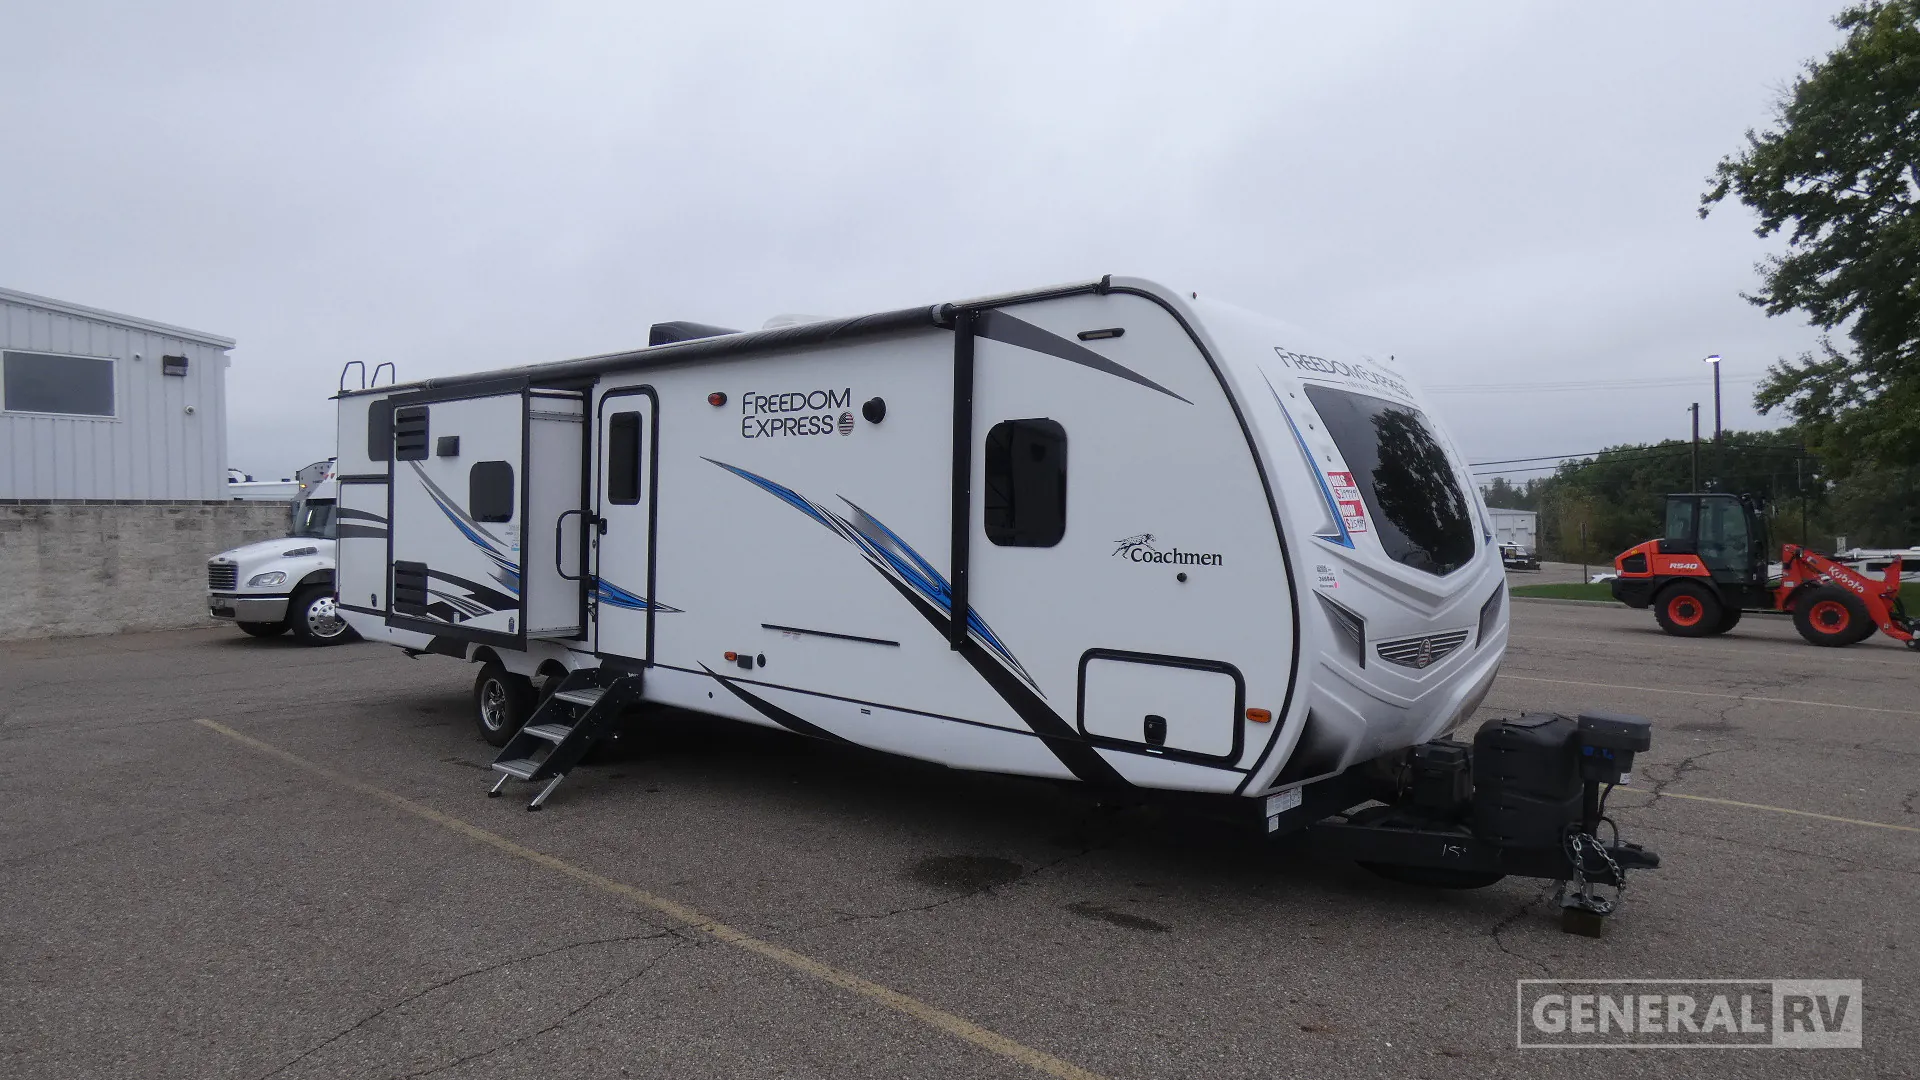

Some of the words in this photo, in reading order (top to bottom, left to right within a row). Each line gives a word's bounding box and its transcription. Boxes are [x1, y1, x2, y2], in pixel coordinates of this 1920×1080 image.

[742, 387, 851, 415] FREEDOM
[741, 414, 834, 439] EXPRESS
[1328, 474, 1348, 487] WAS
[1340, 503, 1357, 517] NOW
[1130, 547, 1223, 566] Coachmen
[1828, 565, 1865, 593] Kubota
